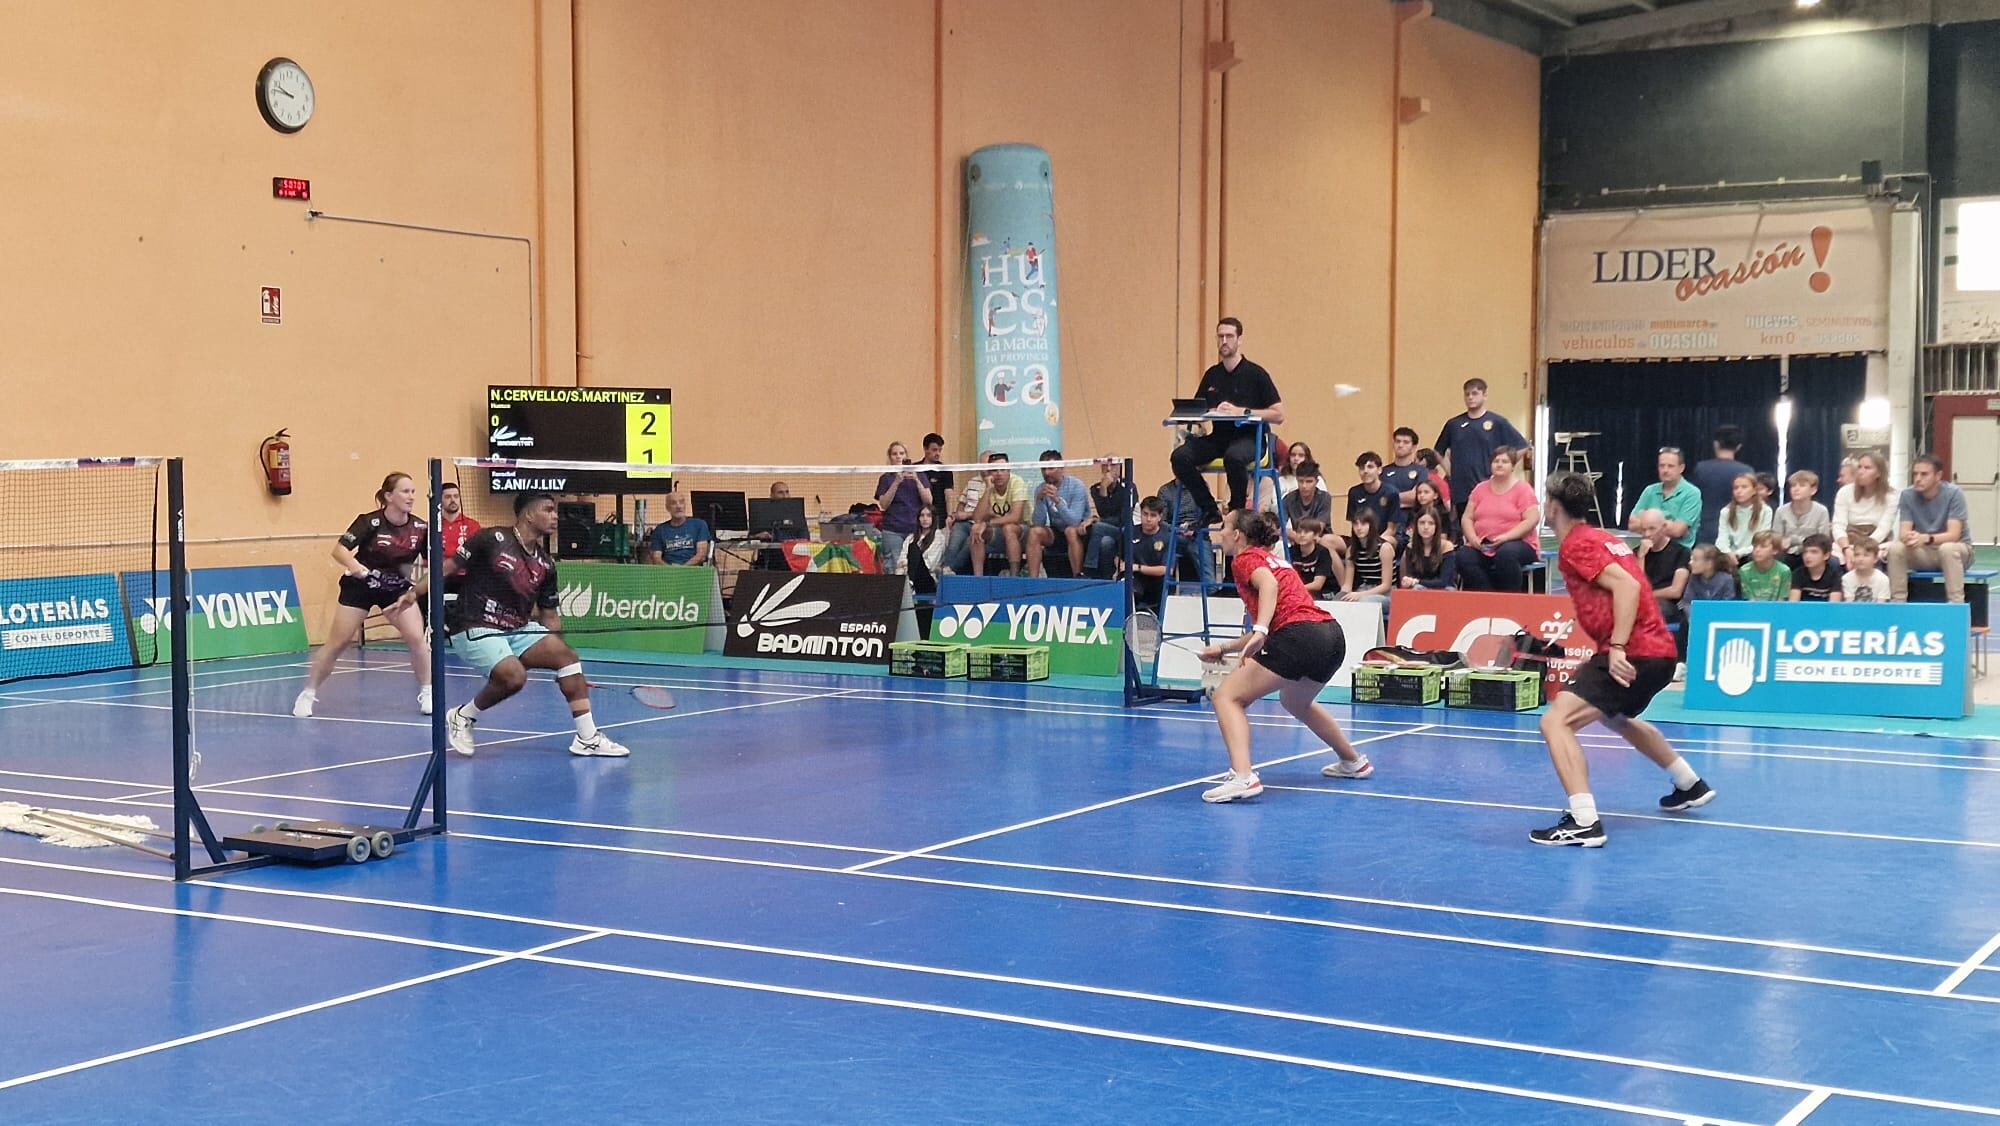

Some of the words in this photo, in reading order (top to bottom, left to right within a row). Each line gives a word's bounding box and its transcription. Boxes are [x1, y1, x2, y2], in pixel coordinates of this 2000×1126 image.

[1592, 246, 1718, 284] LIDER
[1675, 242, 1805, 301] ocasión
[490, 389, 645, 404] N.CERVELLO/S.MARTINEZ
[491, 414, 501, 428] 0
[640, 412, 657, 436] 2
[642, 449, 654, 466] 1
[491, 478, 567, 491] S.ANI/J.LILY
[0, 595, 109, 625] LOTERÍAS
[196, 589, 294, 629] YONEX
[596, 591, 699, 623] Iberdrola
[840, 621, 887, 634] ESPAÑA
[1006, 603, 1113, 645] YONEX
[15, 632, 39, 644] CON
[41, 631, 54, 641] EL
[55, 629, 101, 641] DEPORTE
[757, 633, 883, 658] BADMINTON
[1776, 625, 1945, 656] LOTERÍAS
[1794, 665, 1824, 676] CON
[1832, 666, 1847, 676] EL
[1853, 666, 1922, 678] DEPORTE
